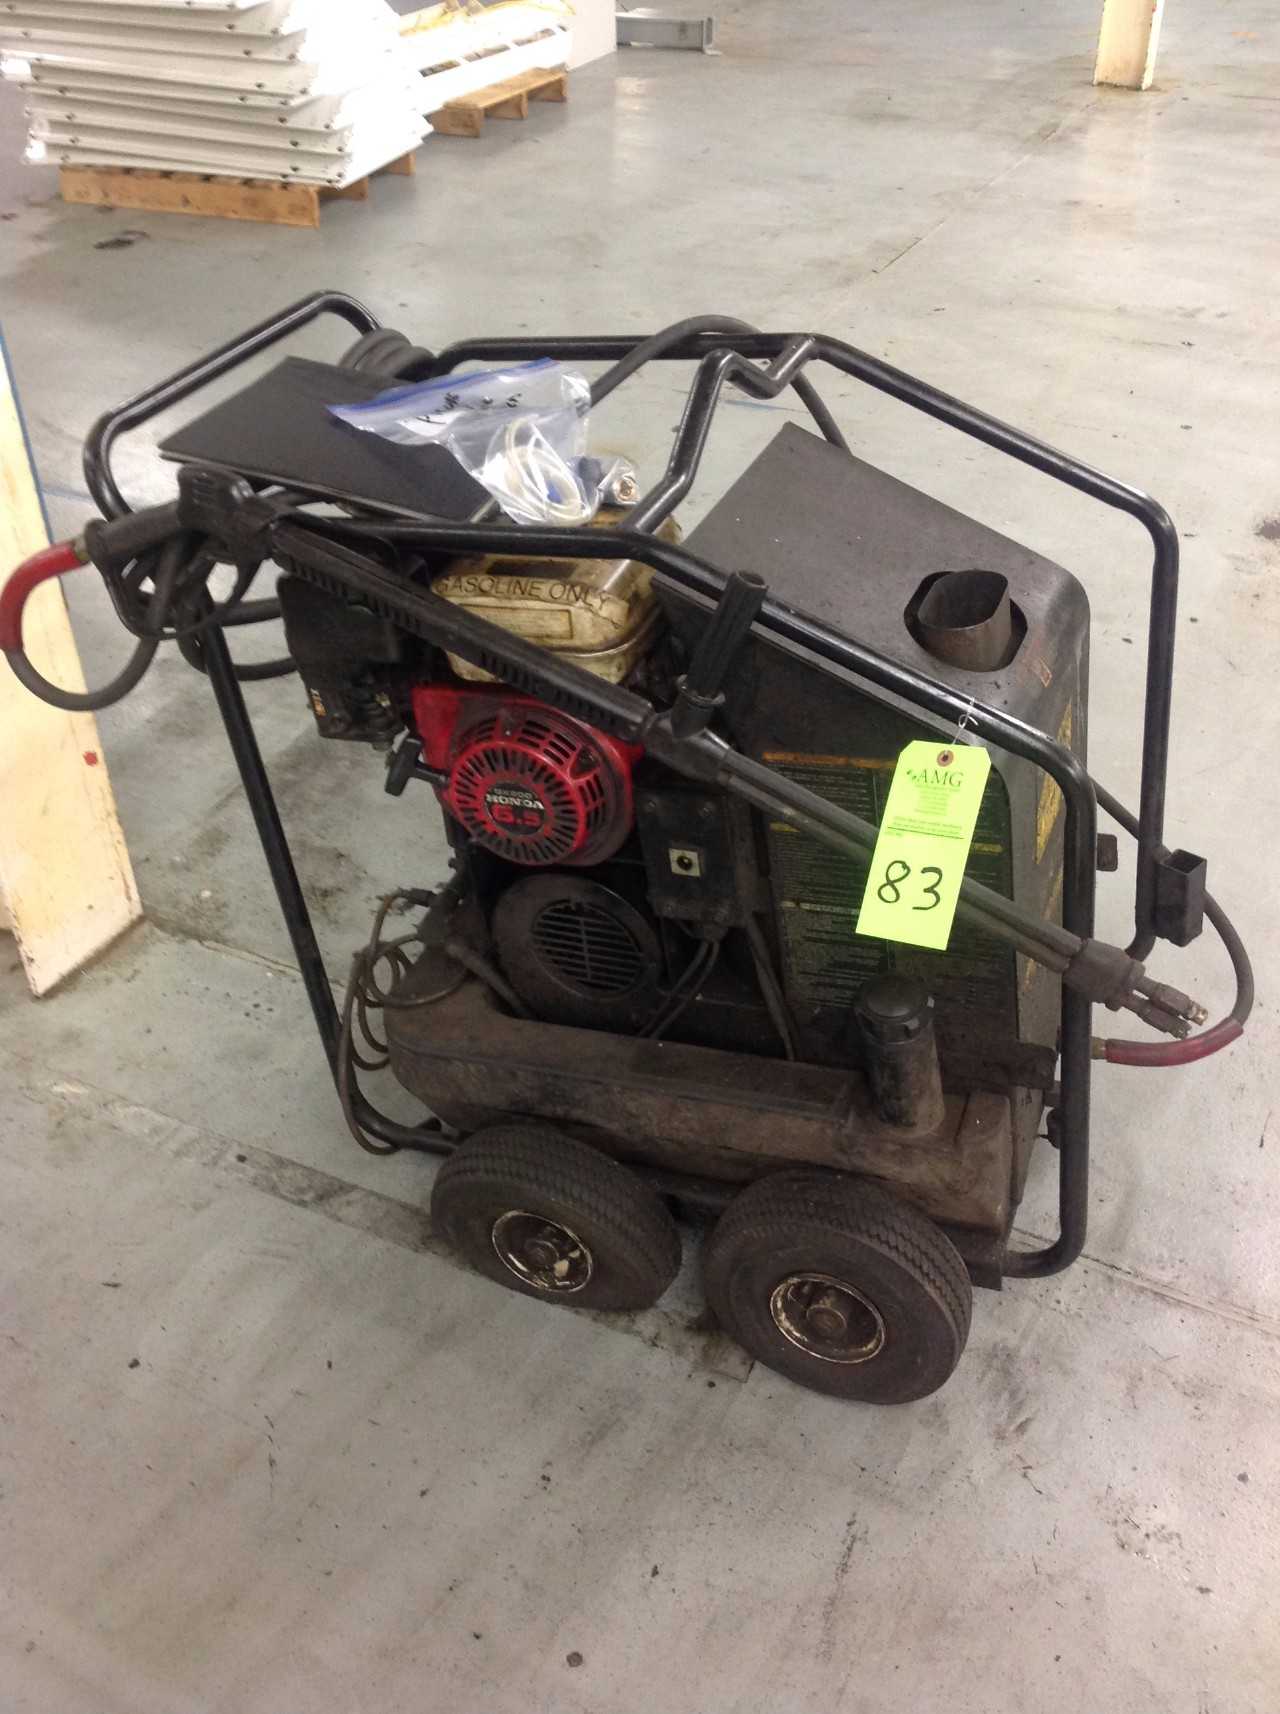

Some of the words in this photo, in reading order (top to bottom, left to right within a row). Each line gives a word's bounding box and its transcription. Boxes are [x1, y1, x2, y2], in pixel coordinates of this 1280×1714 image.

[436, 575, 544, 599] GASOLINE
[549, 582, 612, 611] ONLY
[916, 768, 964, 787] AMG
[485, 794, 545, 810] HONDA
[877, 860, 943, 910] 83
